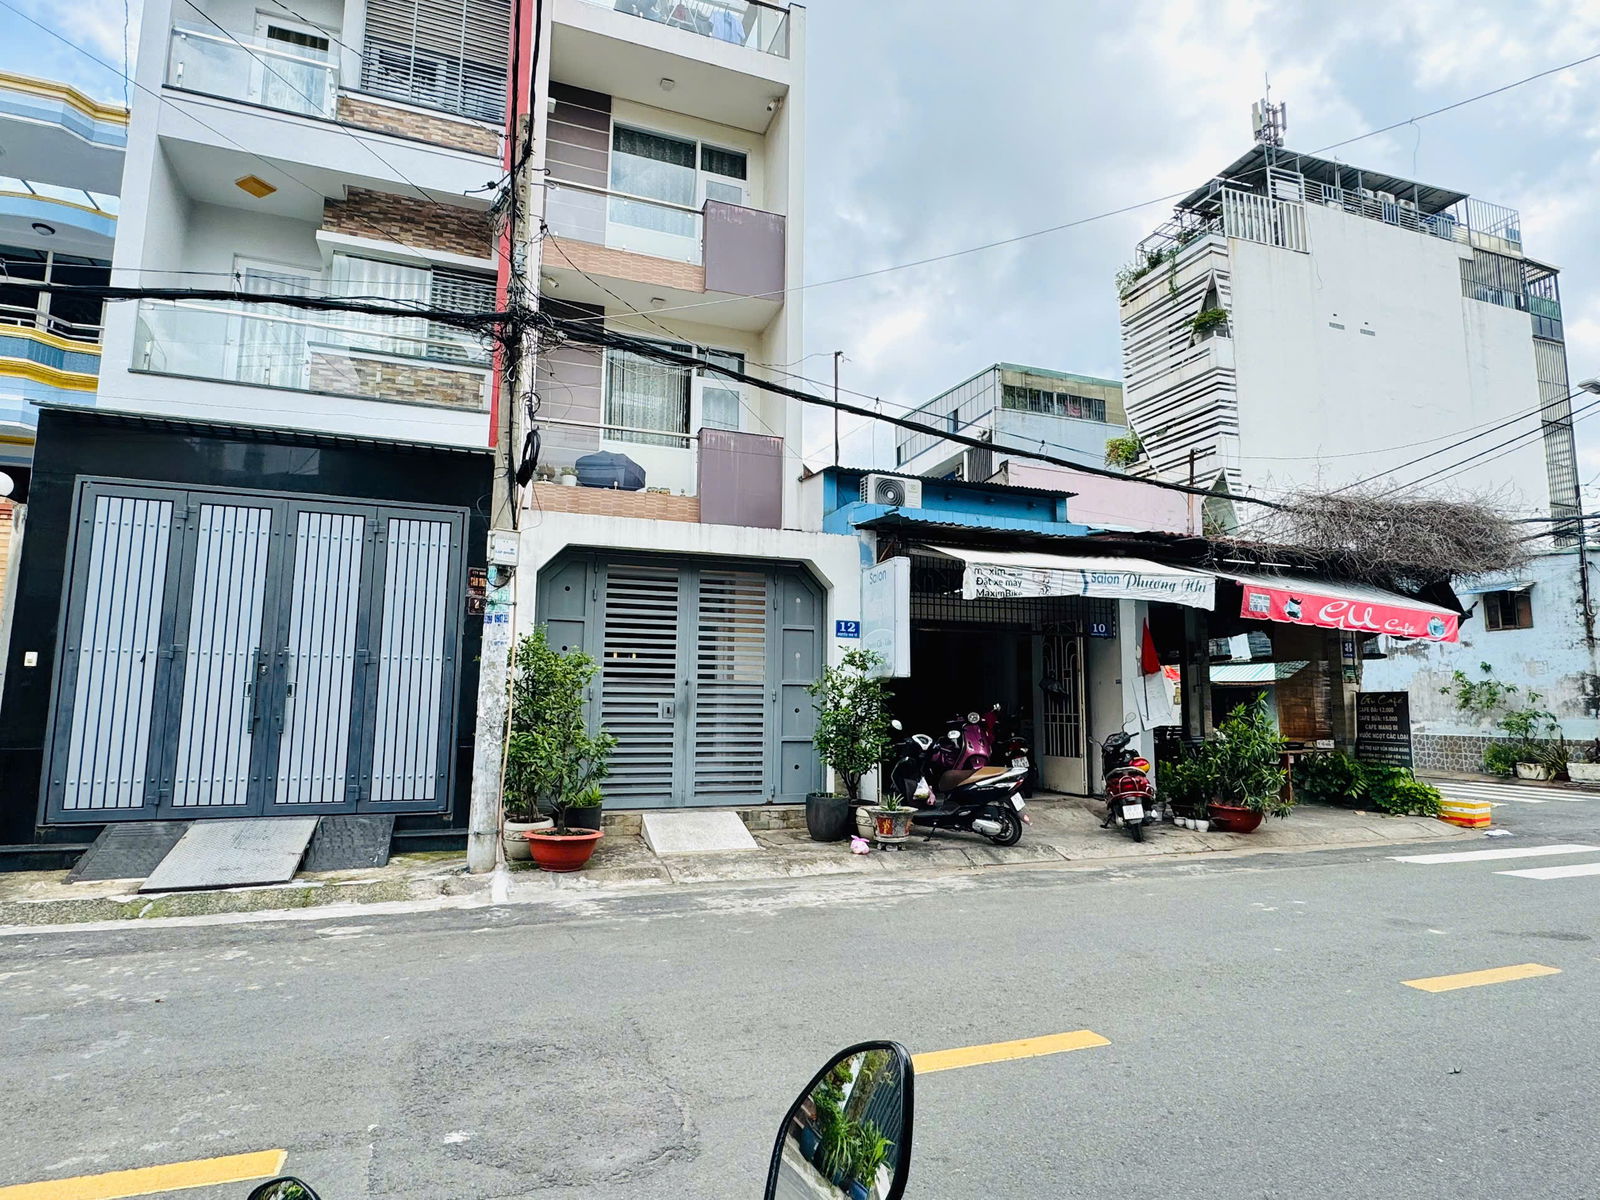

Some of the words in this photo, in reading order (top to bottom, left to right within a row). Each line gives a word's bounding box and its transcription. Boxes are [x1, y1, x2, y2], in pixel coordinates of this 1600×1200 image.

[1091, 573, 1120, 584] Salon
[840, 622, 856, 632] 12
[1093, 624, 1106, 633] 10
